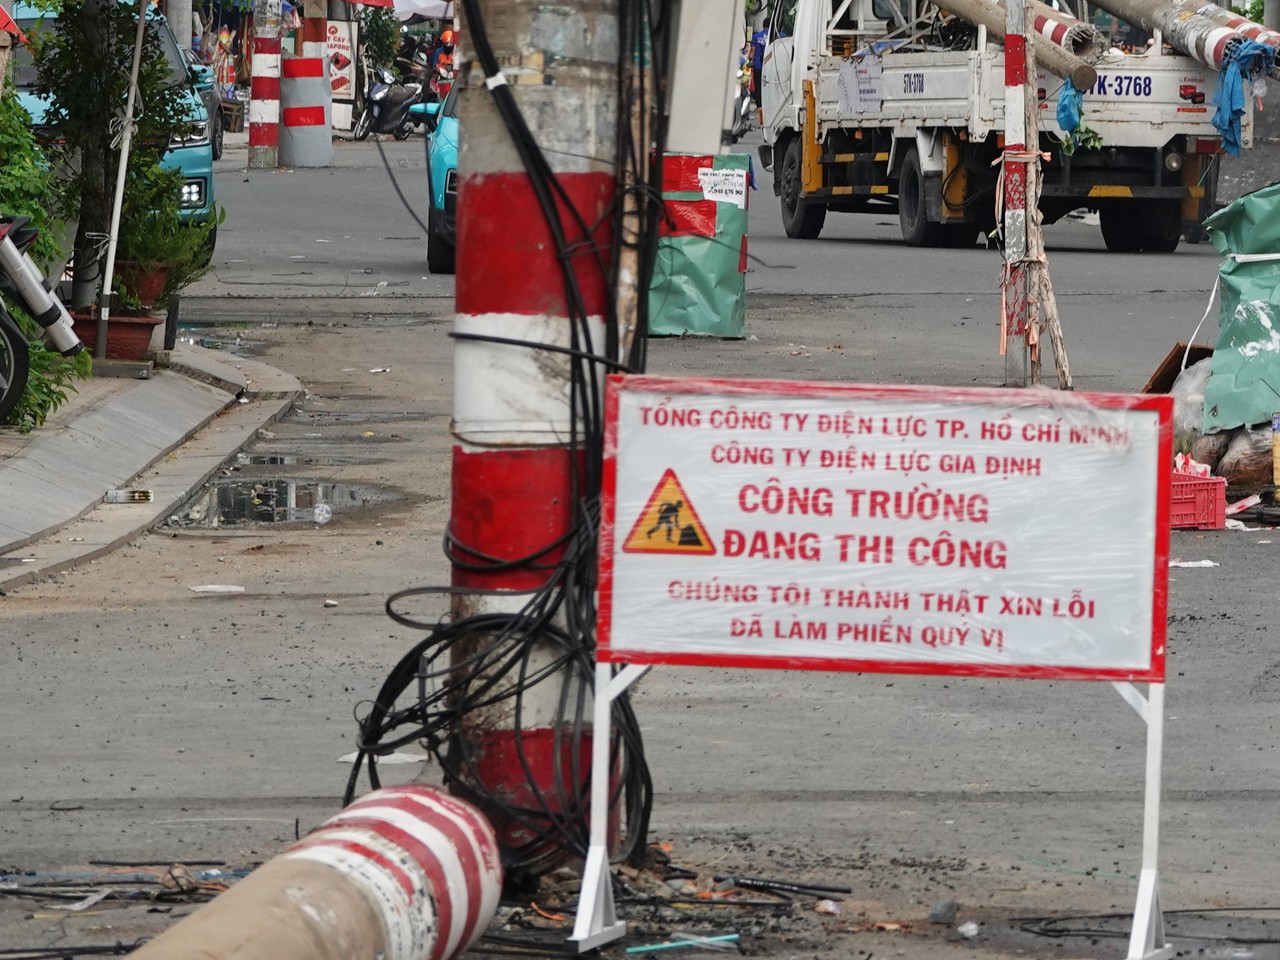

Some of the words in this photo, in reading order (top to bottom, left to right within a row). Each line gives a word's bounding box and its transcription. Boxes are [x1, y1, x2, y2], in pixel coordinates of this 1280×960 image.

[640, 396, 701, 427] TỔNG
[709, 405, 772, 431] CÔNG
[780, 413, 810, 432] TY
[817, 410, 873, 439] ĐIỆN
[882, 415, 927, 442] LỰC
[936, 419, 969, 440] TP.
[981, 414, 1013, 441] HỒ
[1021, 417, 1063, 443] CHÍ
[711, 440, 774, 466] CÔNG
[782, 448, 812, 467] TY
[820, 446, 876, 474] ĐIỆN
[885, 450, 931, 477] LỰC
[939, 454, 977, 475] GIA
[985, 455, 1042, 480] ĐỊNH
[738, 477, 834, 517] CÔNG
[845, 482, 989, 524] TRƯỜNG
[722, 529, 821, 562] ĐANG
[833, 533, 894, 564] THI
[907, 530, 1008, 570] CÔNG
[667, 576, 759, 603] CHÚNG
[767, 582, 811, 606] TÔI
[820, 582, 910, 611] THÀNH
[920, 588, 989, 618] THẬT
[999, 595, 1043, 617] XIN
[1052, 588, 1095, 619] LỖI
[730, 613, 764, 638] ĐÃ
[774, 614, 828, 641] LÀM
[837, 615, 912, 644] PHIỀN
[920, 620, 970, 648] QUÝ
[980, 628, 1005, 653] VỊ
